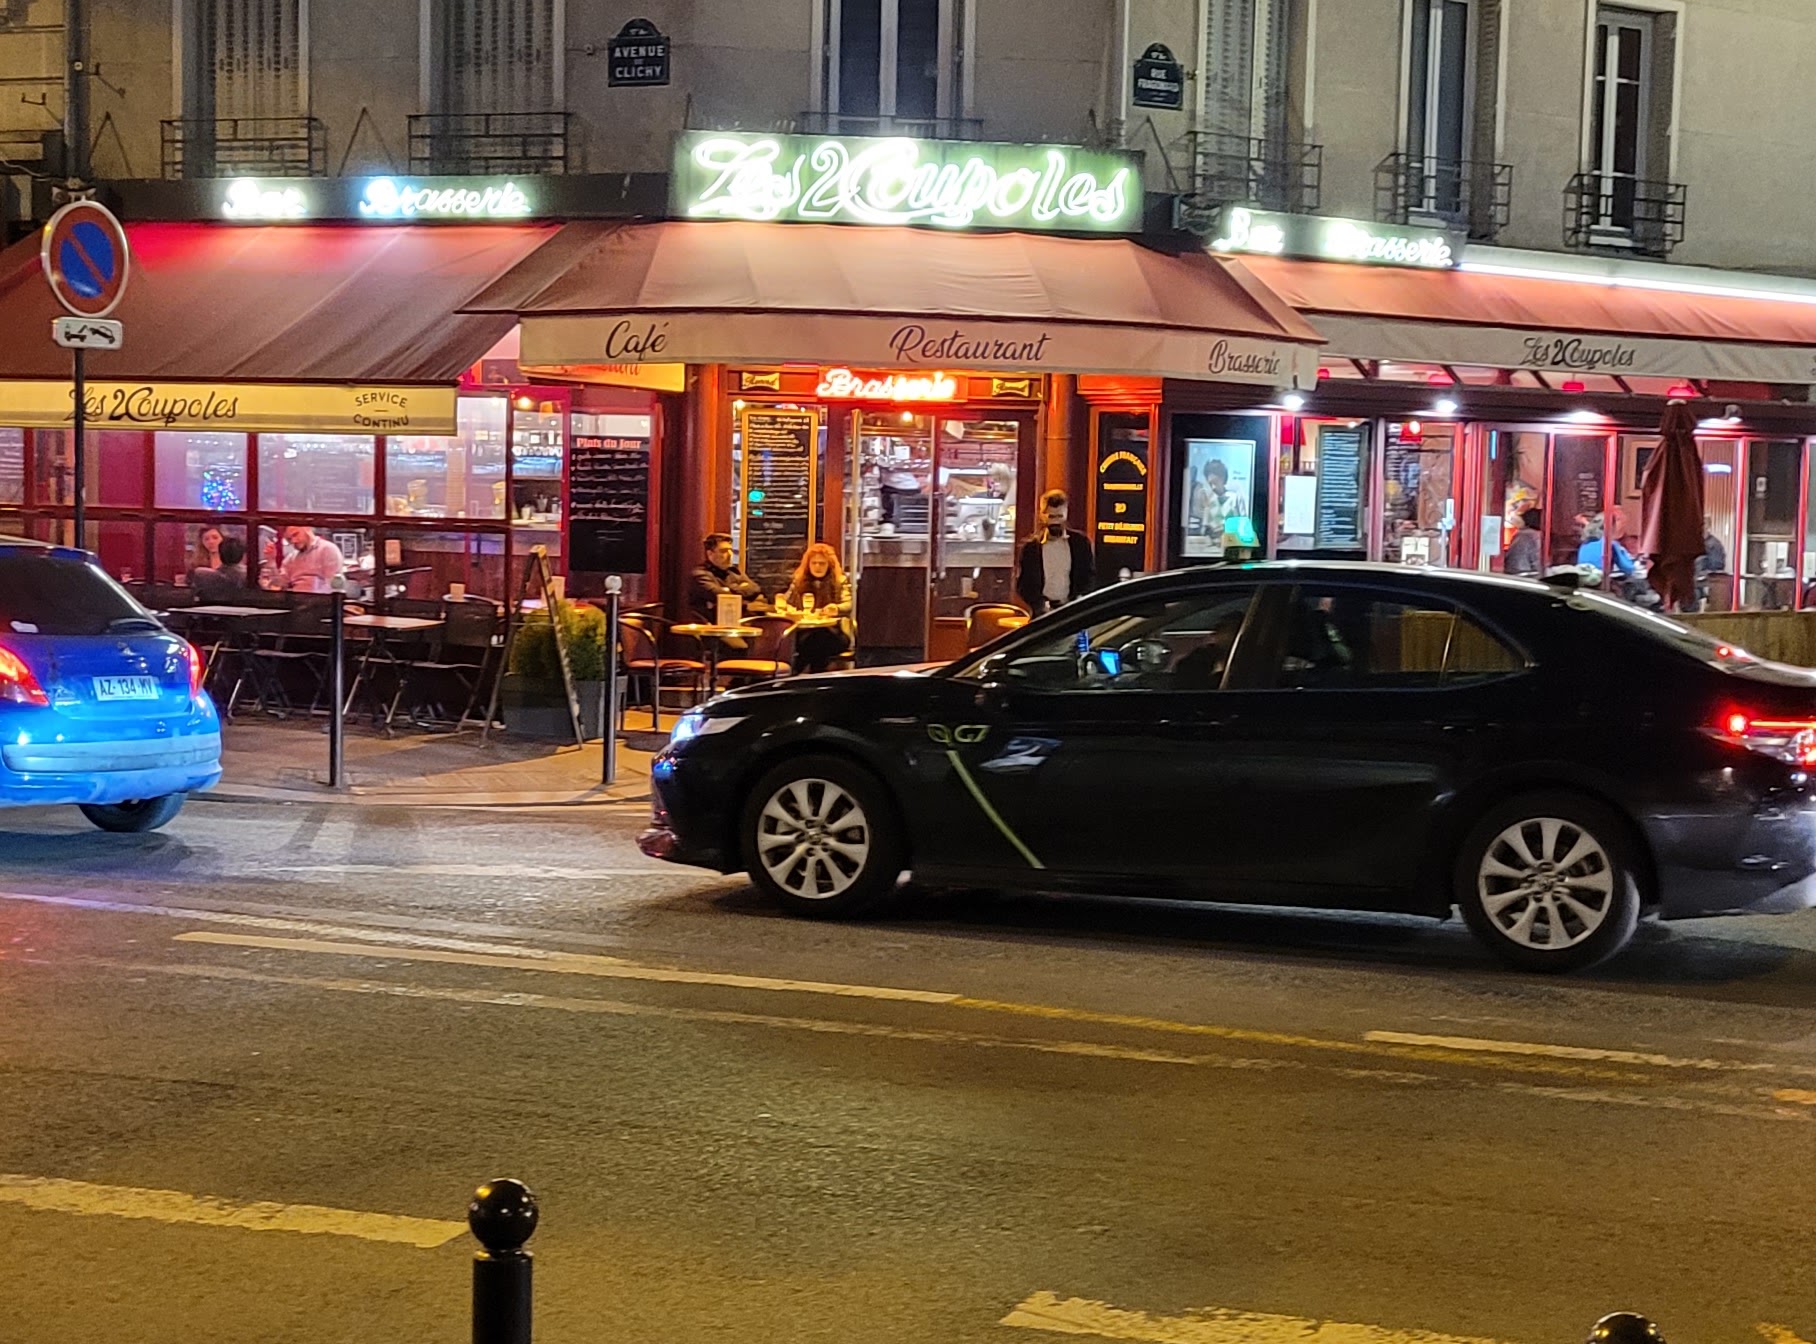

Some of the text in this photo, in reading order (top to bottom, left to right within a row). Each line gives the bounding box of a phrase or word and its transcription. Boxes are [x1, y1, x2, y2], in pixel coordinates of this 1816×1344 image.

[614, 45, 665, 57] AVENUE
[615, 66, 661, 77] CLICHY
[360, 177, 532, 217] Brasserie
[689, 137, 804, 220] Les
[842, 137, 1129, 227] Coupoles
[605, 320, 670, 361] Café
[889, 324, 1053, 363] Restaurant
[1208, 339, 1281, 375] Brasserie
[1519, 336, 1551, 367] Les
[1562, 338, 1636, 370] Coupoles
[125, 386, 239, 427] Coupoles
[354, 391, 408, 408] SERVICE
[353, 413, 409, 429] CONTINU
